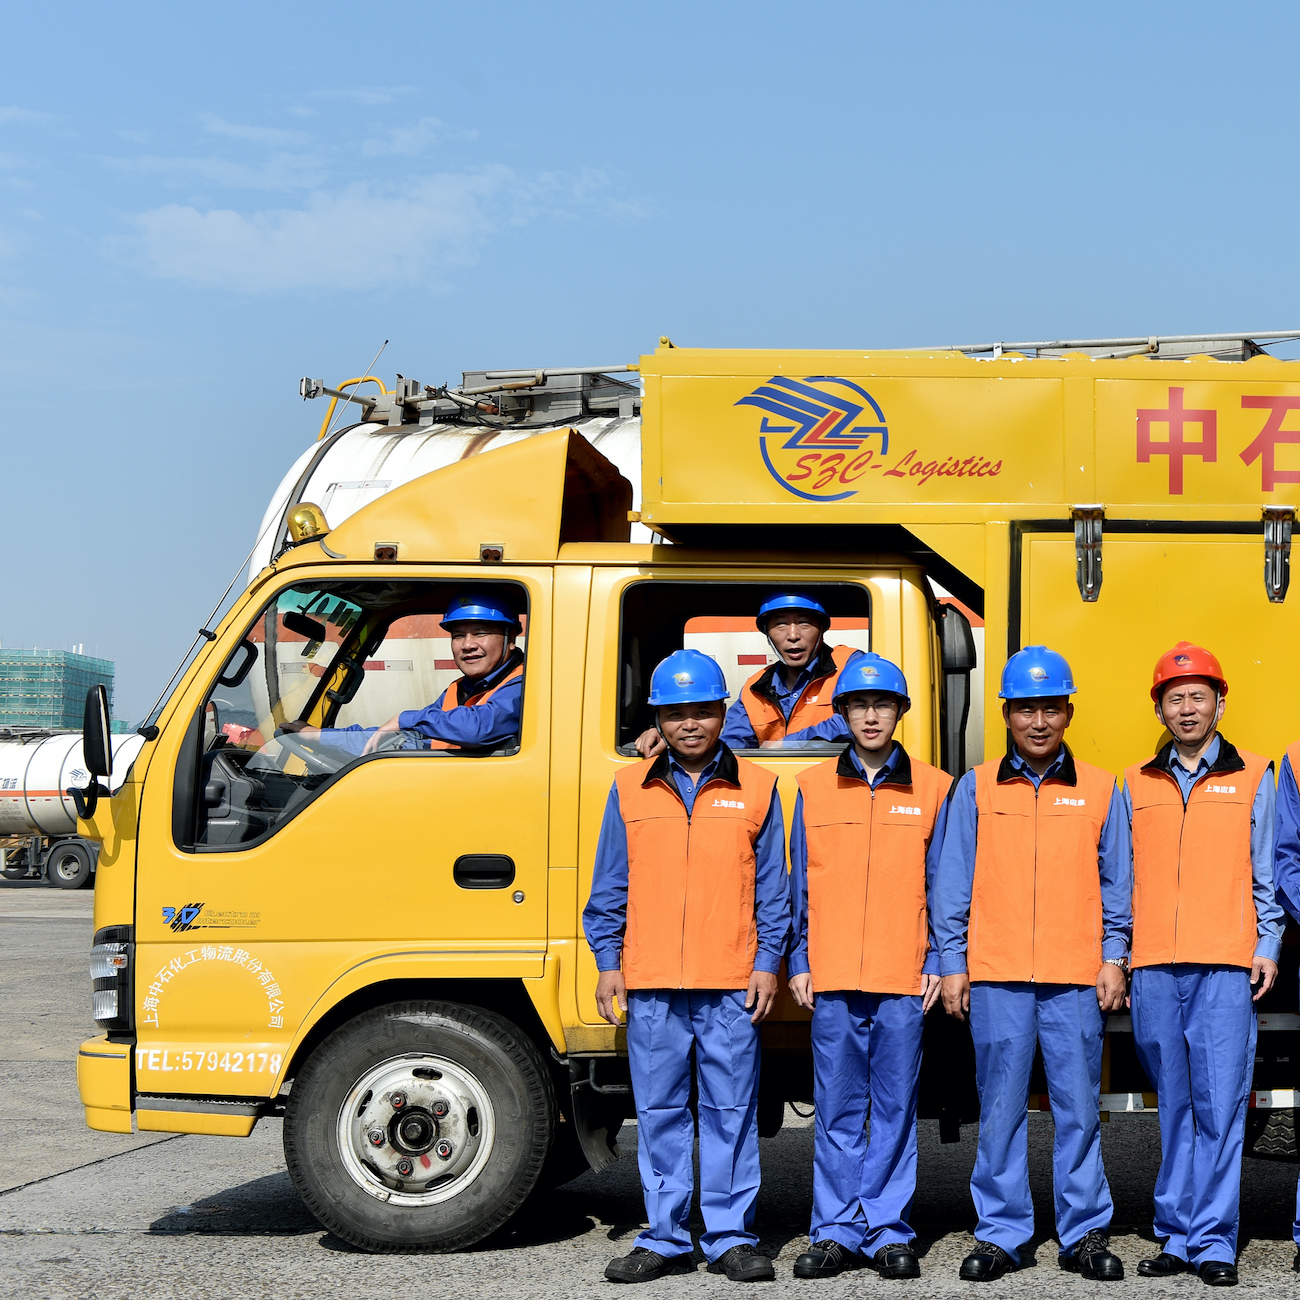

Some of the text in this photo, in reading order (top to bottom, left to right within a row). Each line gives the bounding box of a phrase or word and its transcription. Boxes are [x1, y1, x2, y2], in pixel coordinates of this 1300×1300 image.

[786, 449, 1003, 490] SZC-Logistics
[1204, 784, 1237, 795] 上海应急
[711, 799, 745, 810] 上海应急
[1054, 796, 1086, 807] 上海应急
[889, 805, 921, 816] 上海应急
[143, 945, 284, 1029] 上海中石化工物流股份有限公司
